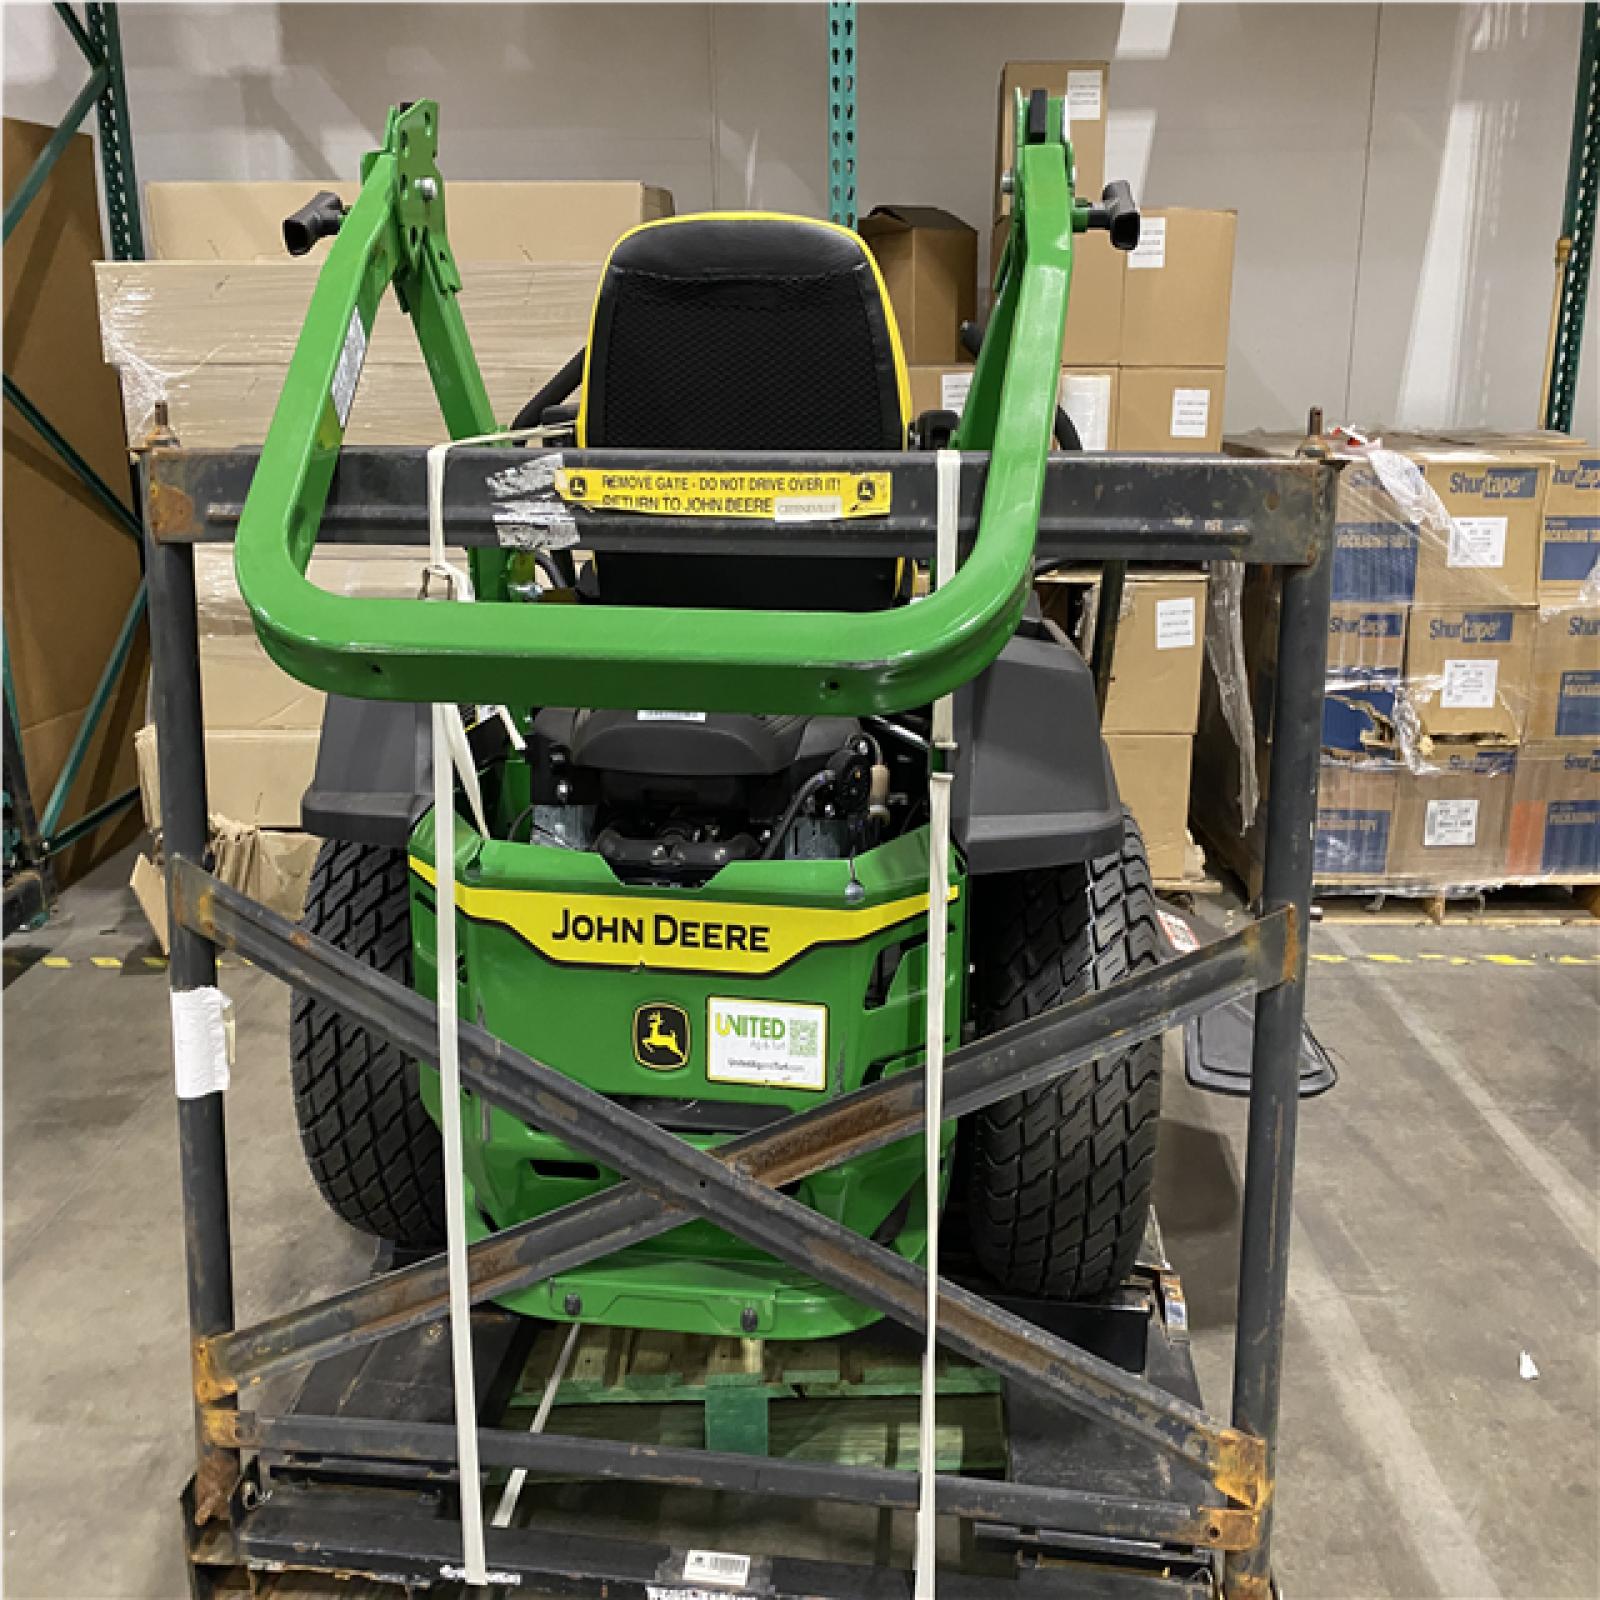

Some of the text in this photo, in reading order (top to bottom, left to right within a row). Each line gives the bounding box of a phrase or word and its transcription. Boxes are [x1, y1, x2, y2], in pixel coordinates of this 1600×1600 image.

[602, 475, 653, 490] REMOVE
[655, 476, 689, 491] GATE
[699, 477, 717, 491] DO
[720, 477, 745, 491] NOT
[749, 477, 786, 491] DRIVE
[788, 477, 823, 491] OVER
[825, 477, 841, 491] IT!
[1449, 471, 1524, 498] Shurtape
[602, 494, 772, 513] RETURN TO JOHN DEERE
[551, 907, 771, 953] JOHN DEERE
[714, 1011, 786, 1041] UNITED
